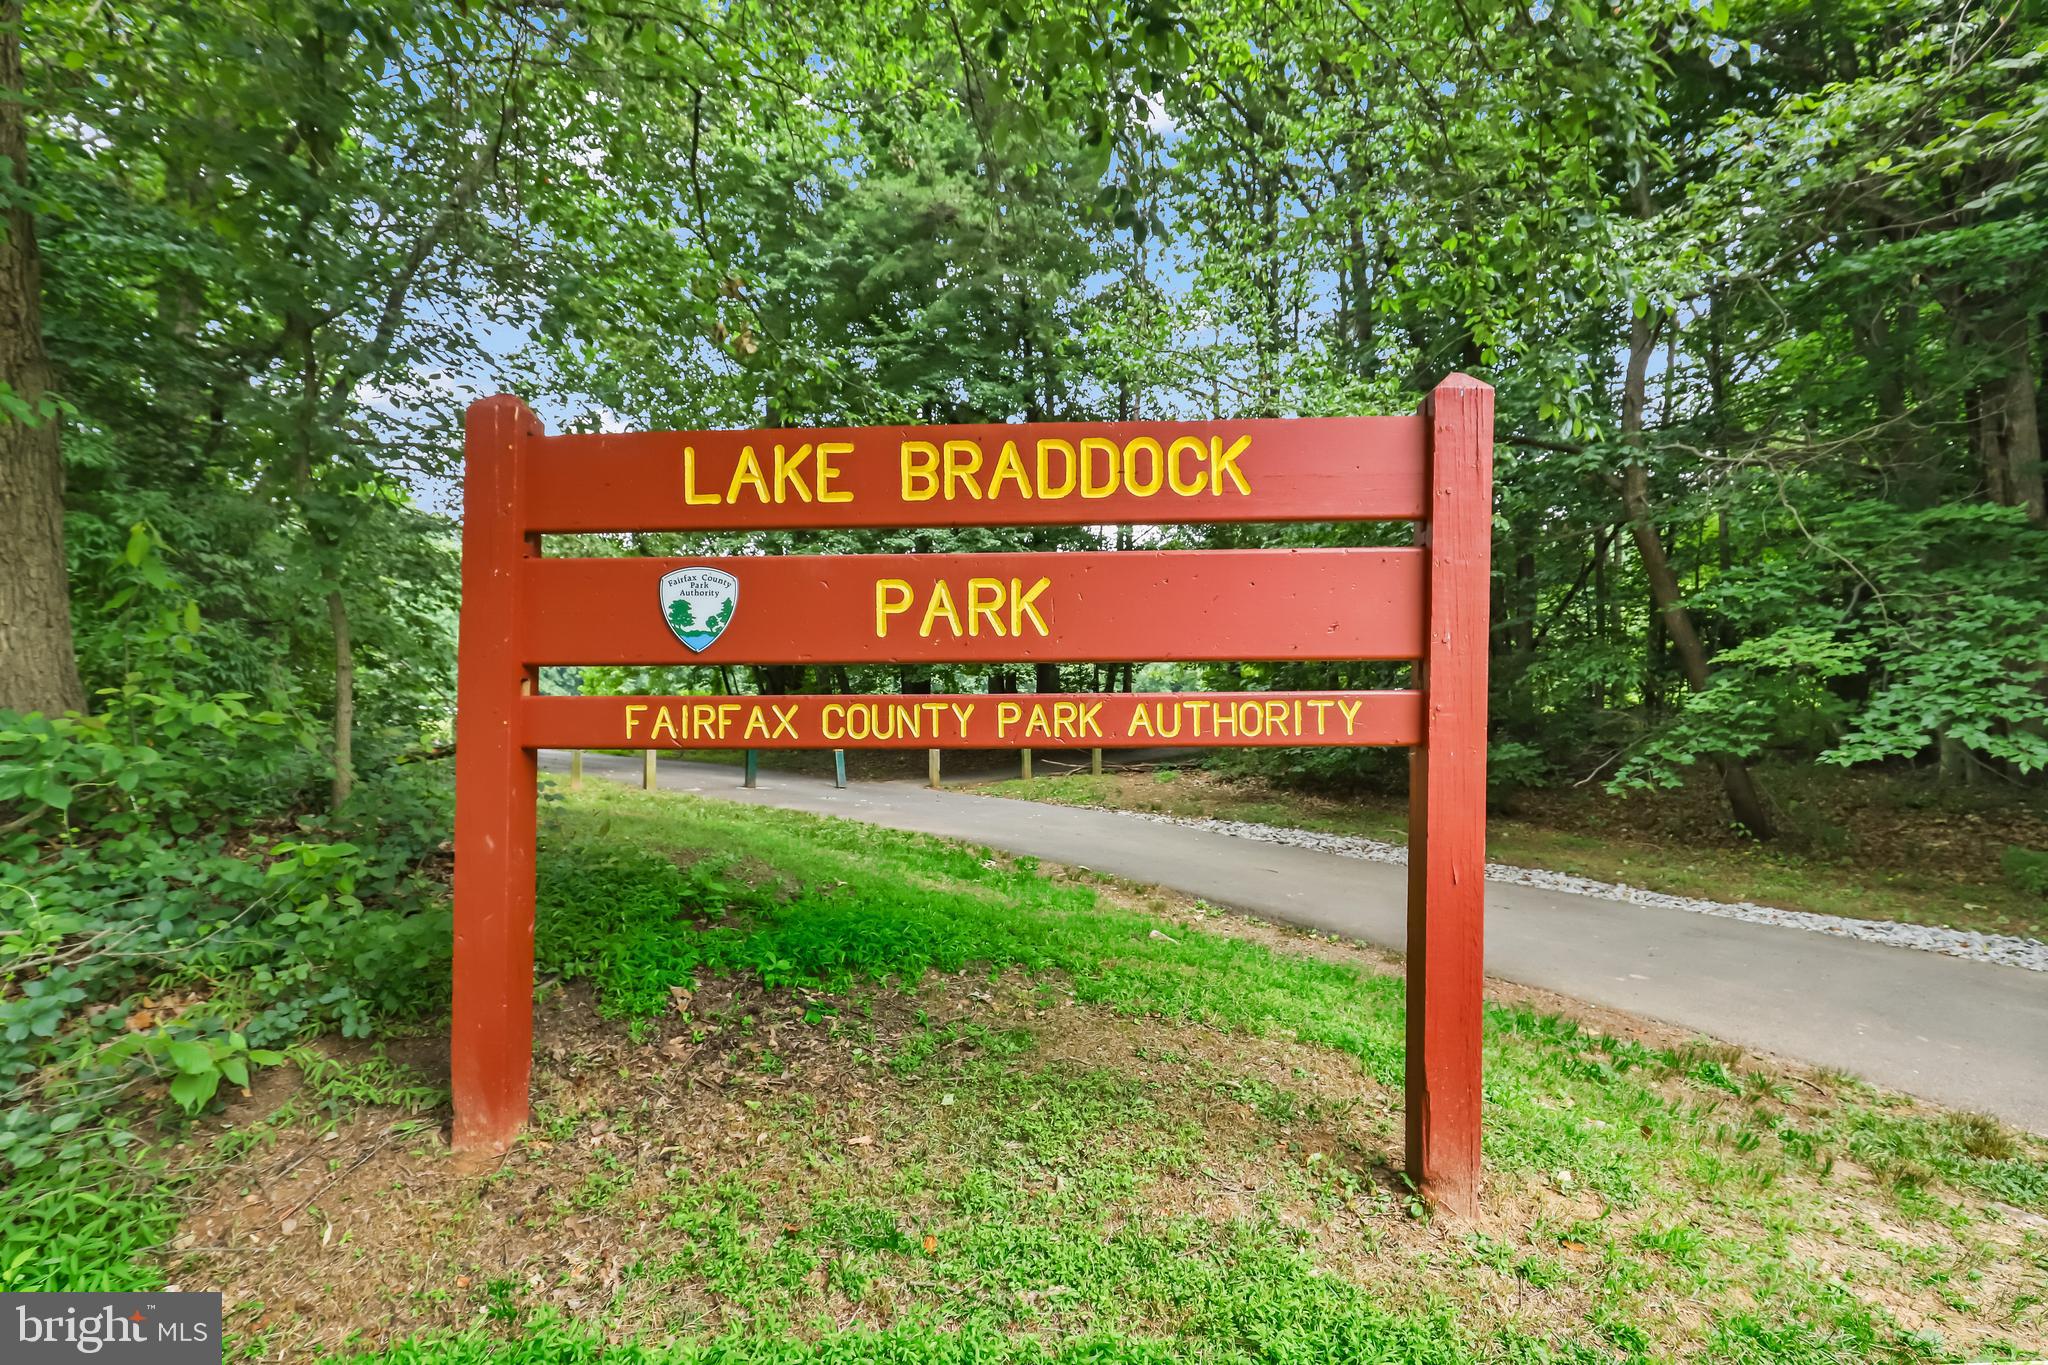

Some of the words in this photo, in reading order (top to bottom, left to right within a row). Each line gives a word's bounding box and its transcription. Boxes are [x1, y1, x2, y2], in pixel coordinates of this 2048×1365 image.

[683, 442, 855, 506] LAKE
[900, 434, 1253, 502] BRADDOCK
[668, 574, 697, 587] Fairfax
[701, 574, 732, 588] County
[680, 589, 720, 598] Authority
[690, 581, 709, 589] Park
[875, 577, 1052, 639] PARK
[624, 703, 799, 740] FAIRFAX
[820, 702, 976, 740] COUNTY
[996, 701, 1104, 738] PARK
[1127, 700, 1362, 739] AUTHORITY
